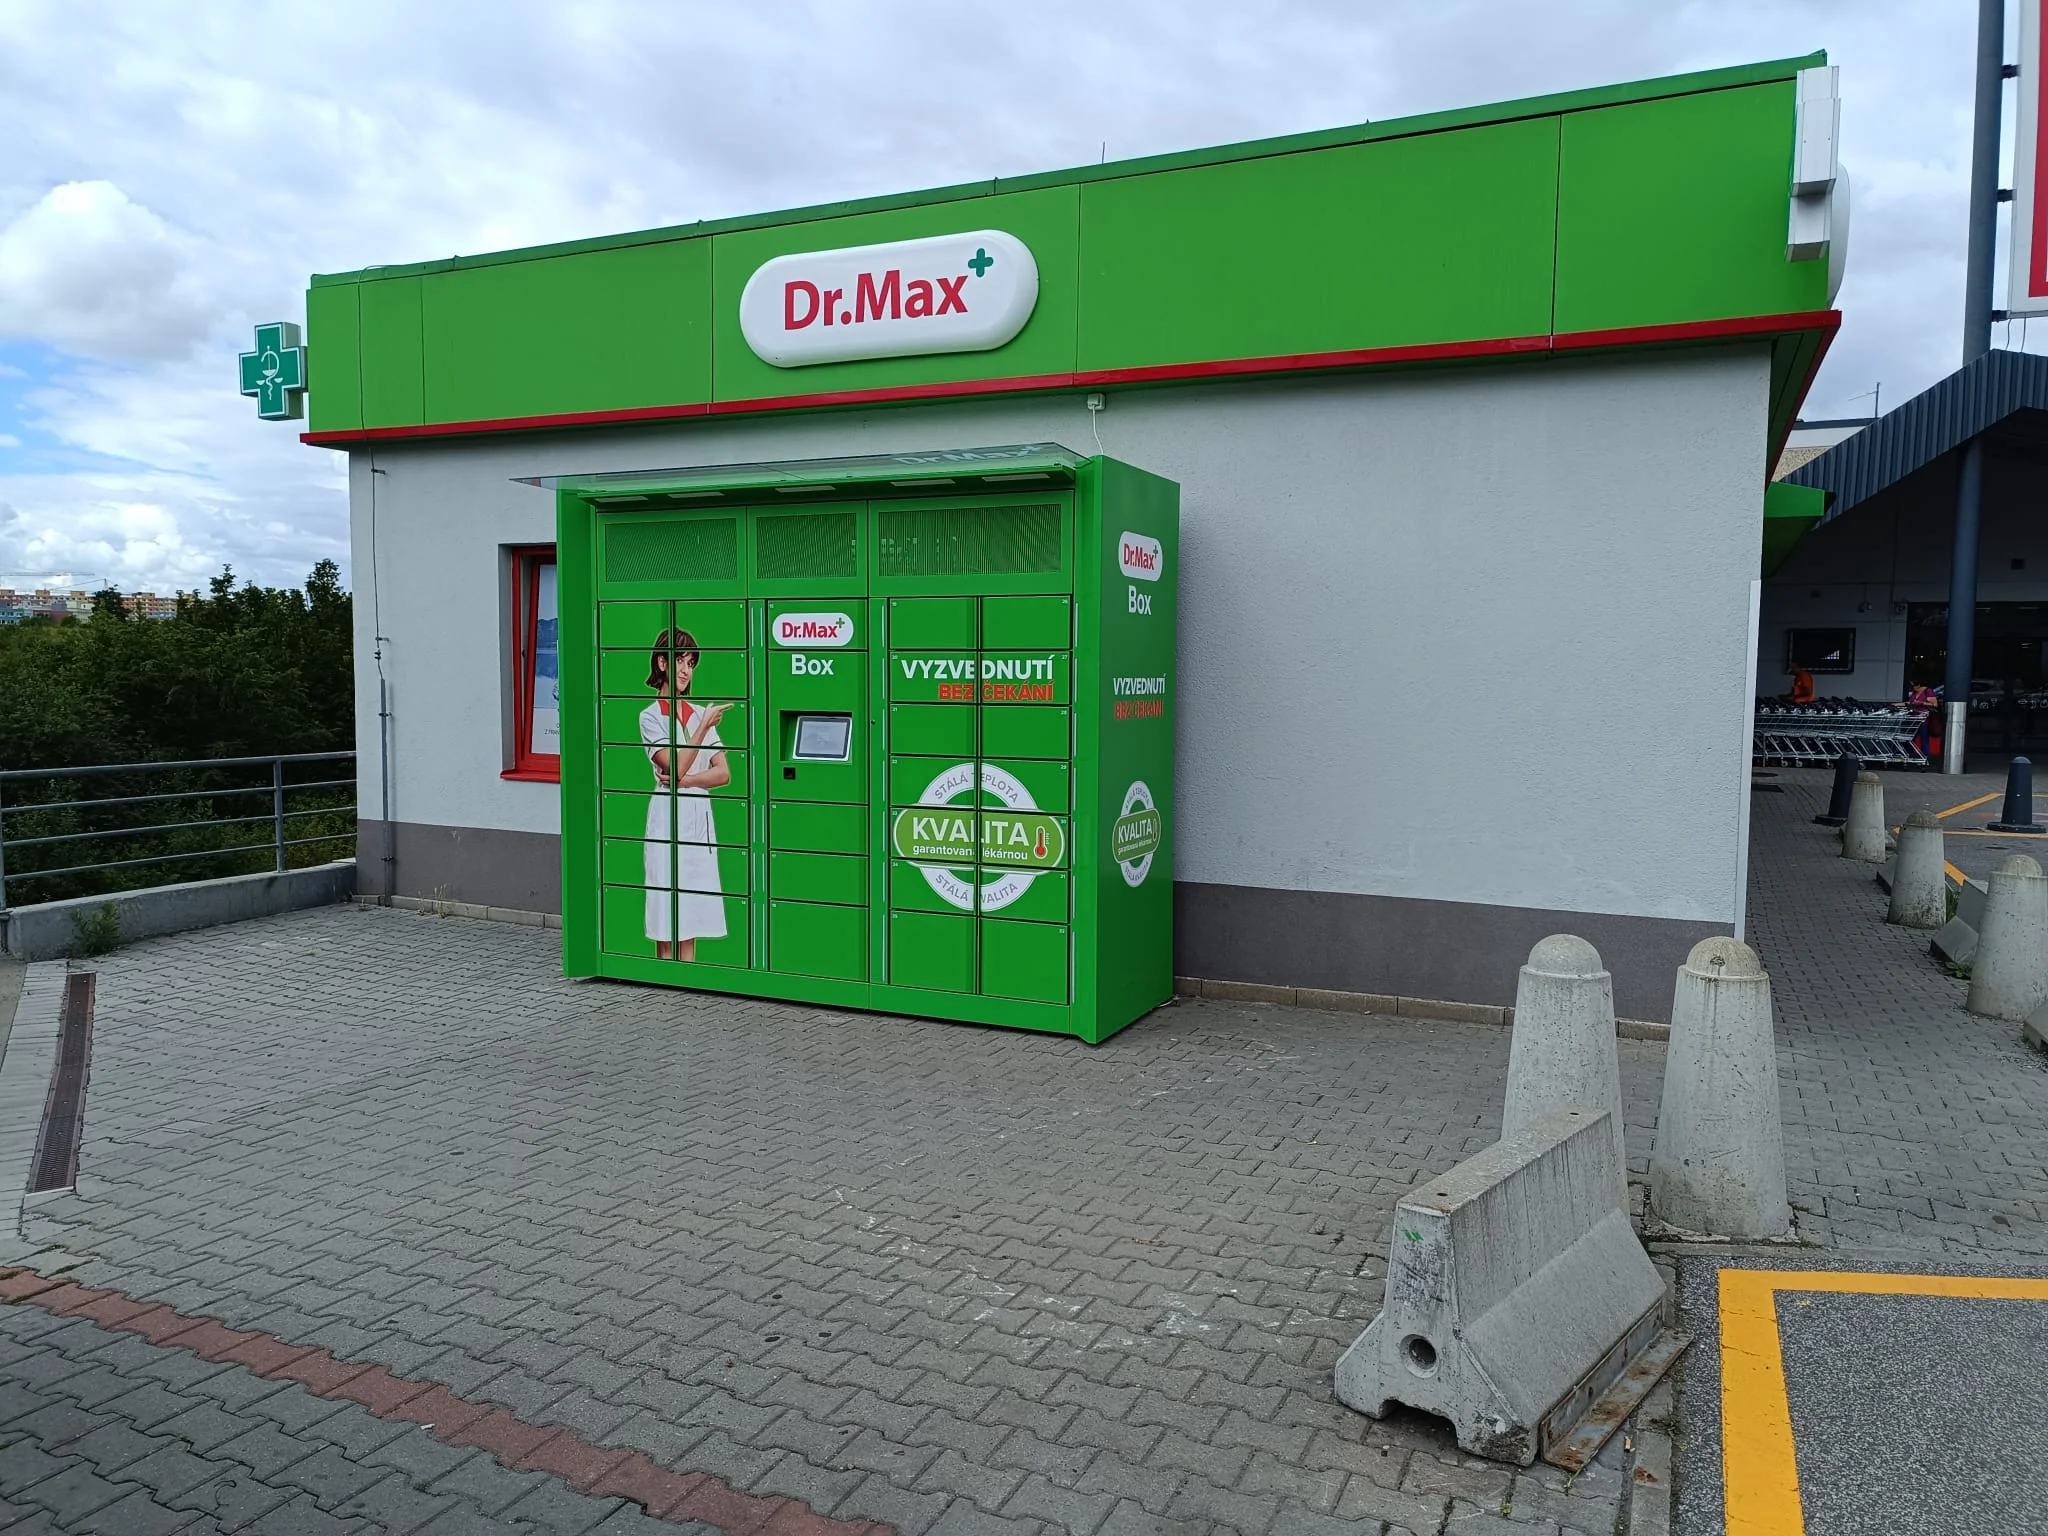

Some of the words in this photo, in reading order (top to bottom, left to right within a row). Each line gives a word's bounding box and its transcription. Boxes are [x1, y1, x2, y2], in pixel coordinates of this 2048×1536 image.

[784, 269, 968, 331] Dr.Max
[1123, 543, 1155, 571] Dr.Max
[1128, 584, 1152, 616] Box
[781, 621, 838, 639] Dr.Max
[791, 654, 834, 676] Box
[901, 655, 1055, 680] VYZVEDNUTÍ
[938, 683, 975, 700] BEZ
[981, 680, 1054, 701] ČEKÁNÍ
[1113, 672, 1167, 696] VYZVEDNUTÍ
[935, 771, 969, 799] STÁLÁ
[971, 772, 1019, 803] EPLOTA
[912, 816, 1030, 847] KVALITA
[1118, 818, 1153, 844] KVALITA
[913, 844, 975, 856] garantovan
[936, 874, 969, 902] STÁLÁ
[980, 883, 1018, 904] VALITA
